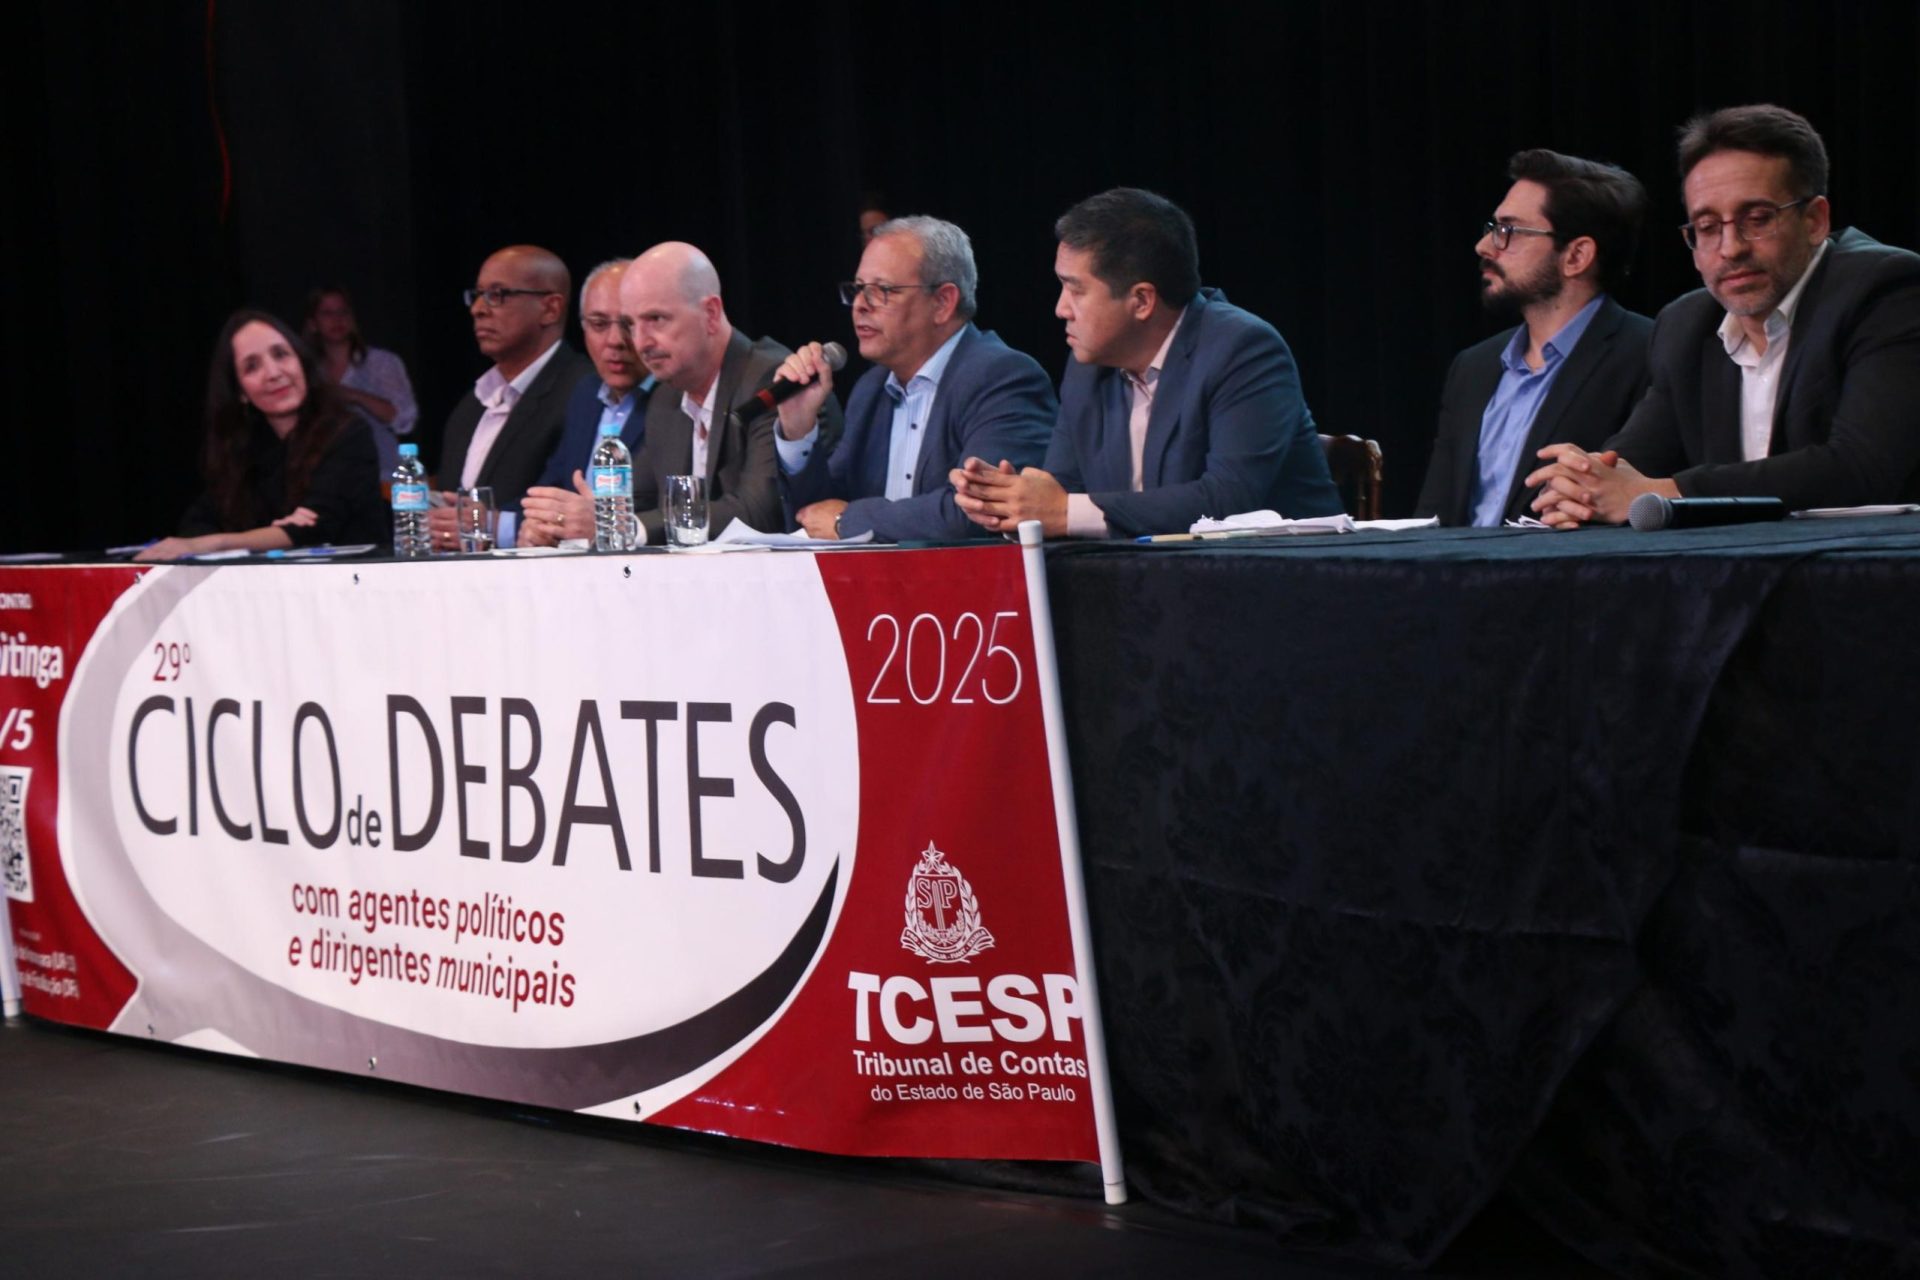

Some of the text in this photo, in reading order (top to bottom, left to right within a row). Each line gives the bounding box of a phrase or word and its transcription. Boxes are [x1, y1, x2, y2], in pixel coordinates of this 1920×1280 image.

[0, 631, 63, 688] itinga
[153, 642, 191, 681] 29º
[867, 612, 1022, 704] 2025
[127, 694, 807, 884] CICLO de DEBATES
[292, 883, 565, 946] com agentes políticos
[288, 928, 576, 1013] e dirigentes municipais
[848, 971, 1083, 1044] TCESP
[853, 1049, 1087, 1078] Tribunal de Contas
[870, 1082, 1076, 1102] do Estado de São Paulo
